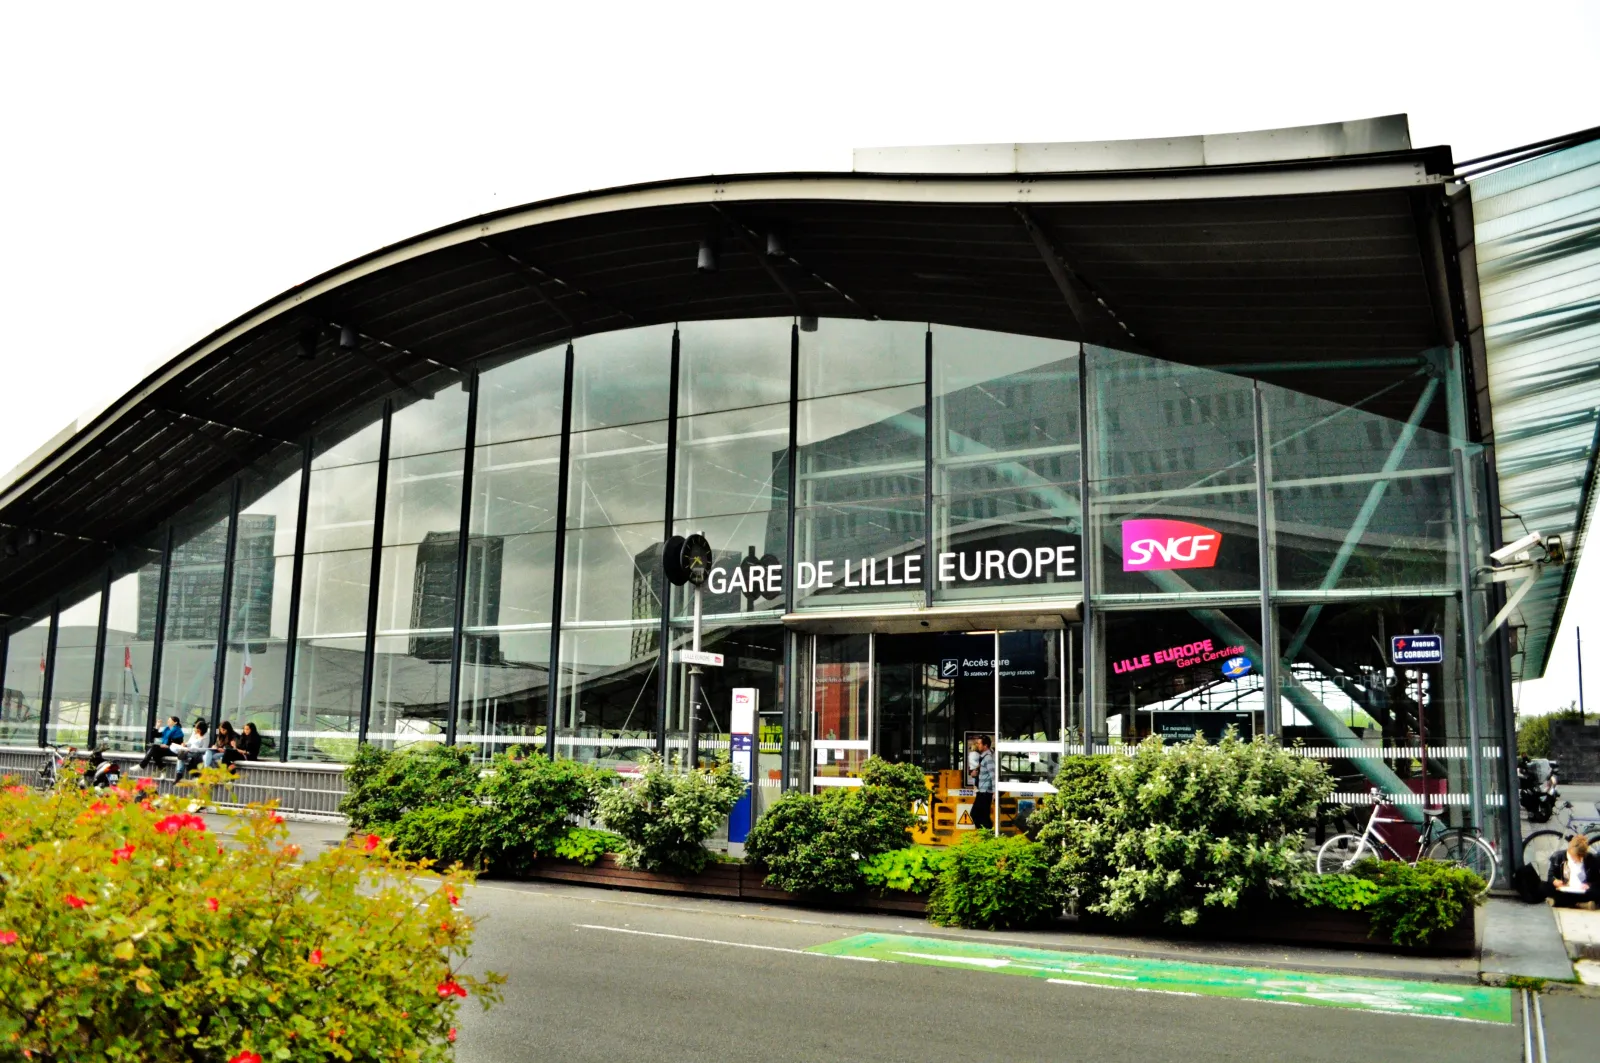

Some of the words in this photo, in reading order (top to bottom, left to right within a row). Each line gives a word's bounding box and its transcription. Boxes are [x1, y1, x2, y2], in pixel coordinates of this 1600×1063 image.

[1128, 534, 1215, 565] SNCF
[707, 565, 783, 594] GARE
[797, 560, 834, 588] DE
[844, 554, 922, 587] LILLE
[938, 545, 1076, 582] EUROPE
[1411, 640, 1435, 648] Avenue
[962, 658, 988, 667] Accès
[1113, 654, 1152, 674] LILLE
[1153, 639, 1213, 664] EUROPE
[1176, 657, 1201, 668] Gare
[1202, 645, 1245, 662] Certifiée
[1228, 657, 1244, 669] NF
[1394, 651, 1403, 659] LE
[1404, 650, 1440, 659] CORBUSIER
